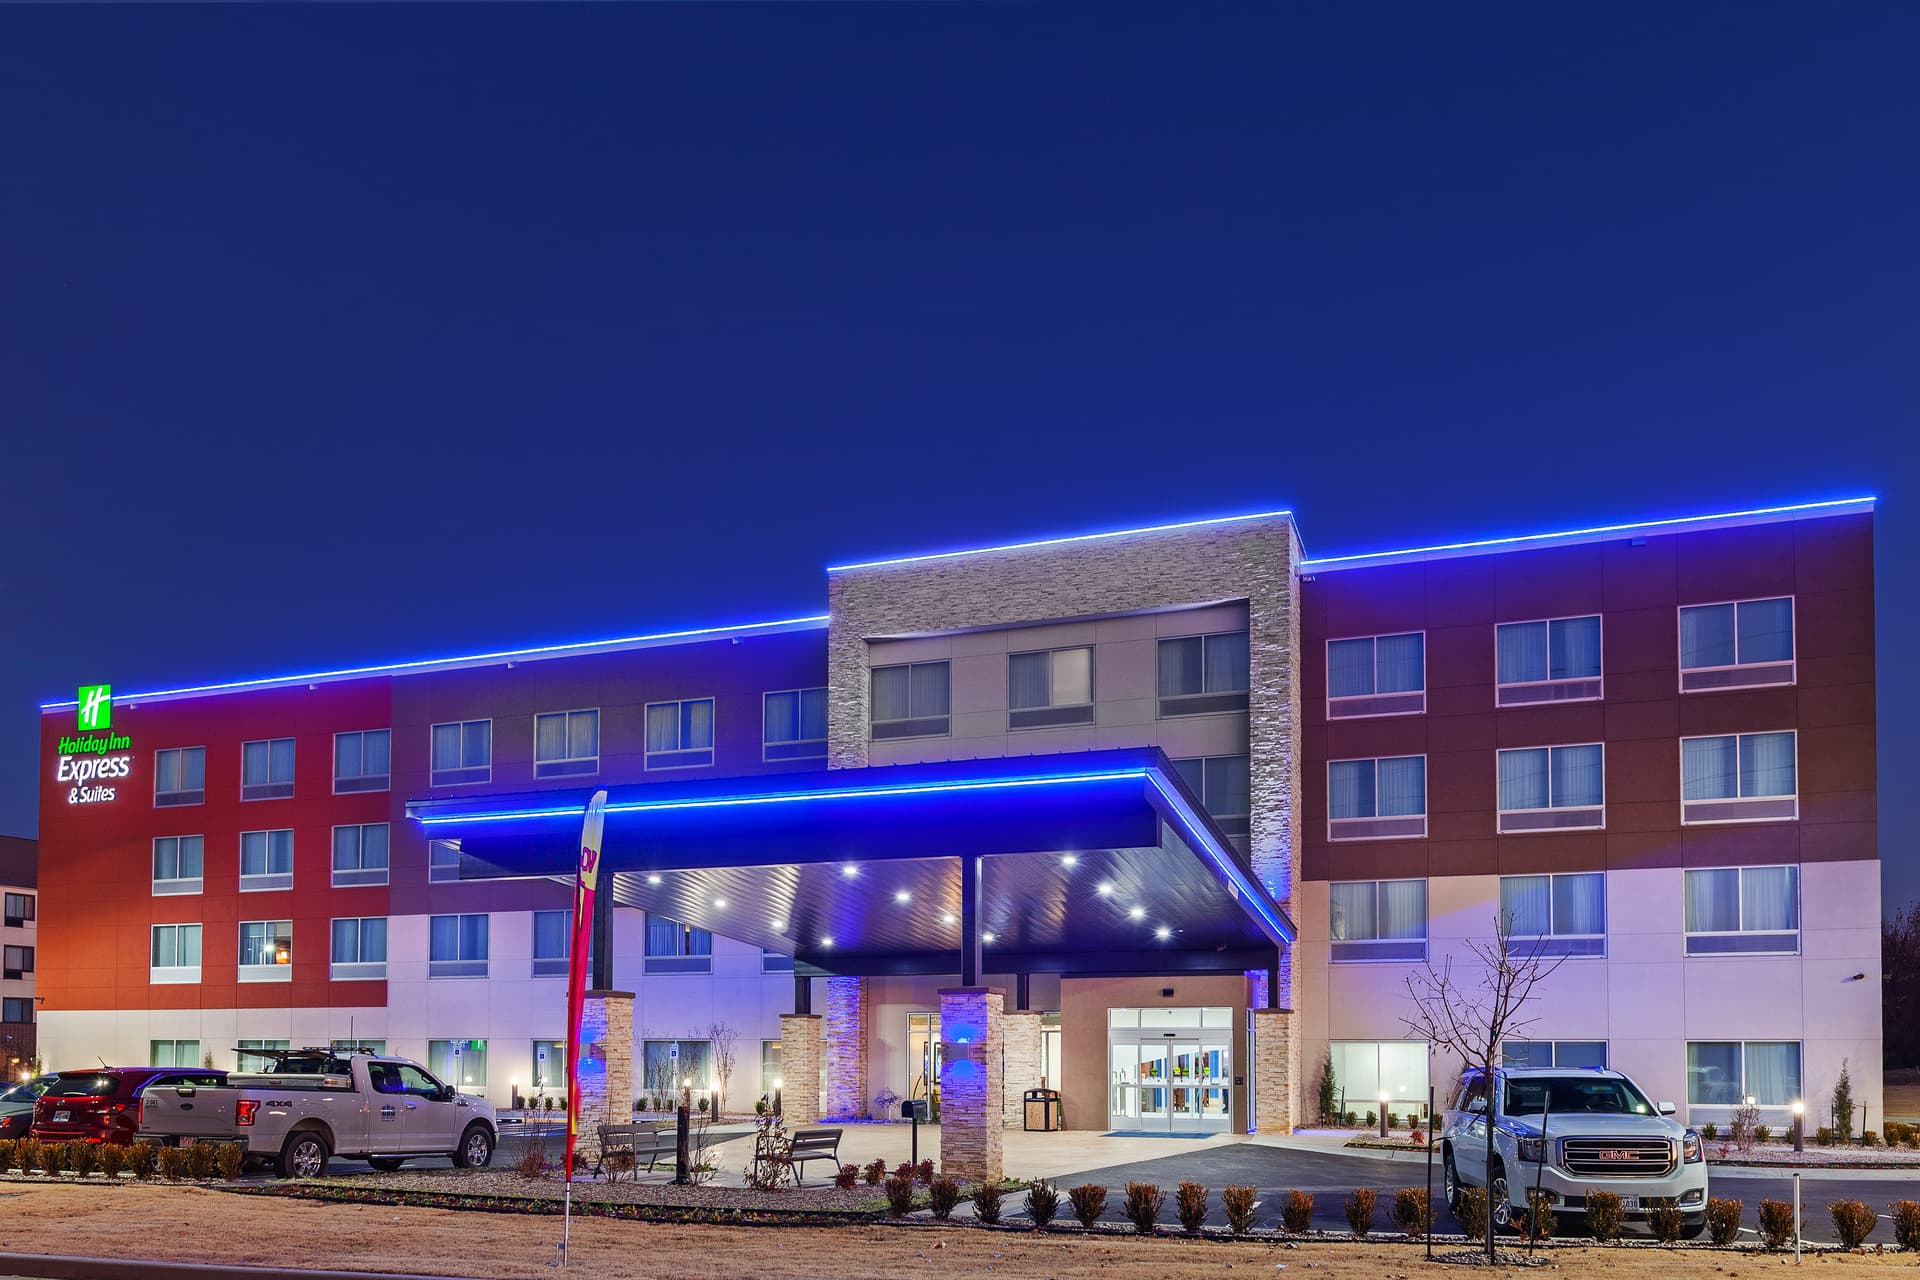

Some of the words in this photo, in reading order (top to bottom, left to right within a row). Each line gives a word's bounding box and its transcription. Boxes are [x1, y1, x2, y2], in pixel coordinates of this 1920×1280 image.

[58, 735, 108, 755] Holiday
[109, 732, 131, 750] Inn
[58, 756, 130, 786] Express
[69, 787, 78, 804] &
[80, 785, 115, 803] Suites
[1599, 1151, 1639, 1160] GMC
